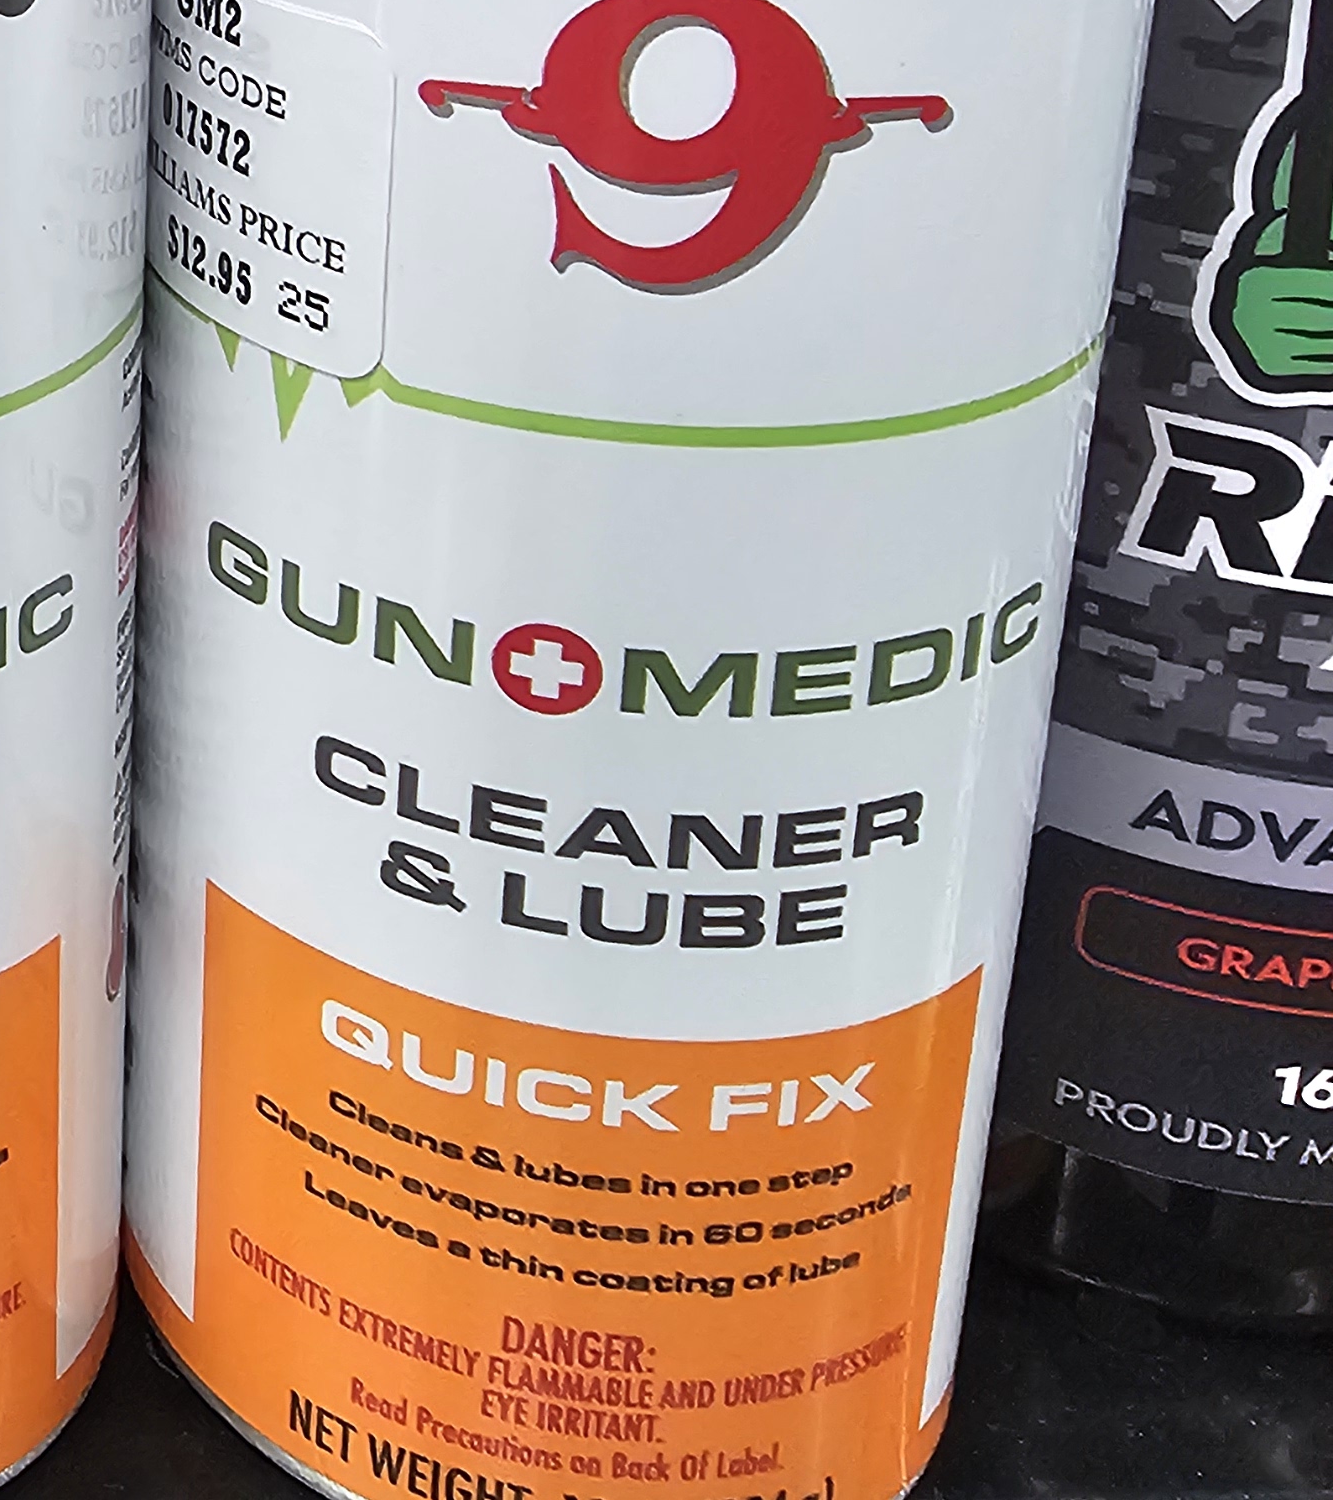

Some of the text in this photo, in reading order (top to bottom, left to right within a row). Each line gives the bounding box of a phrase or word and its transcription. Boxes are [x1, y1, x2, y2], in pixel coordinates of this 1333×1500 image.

[163, 83, 251, 177] 017572
[199, 55, 287, 120] CODE
[167, 213, 252, 306] $12.95
[278, 280, 330, 332] 25
[239, 203, 347, 274] PRICE
[1119, 405, 1333, 595] R
[314, 735, 925, 870] CLEANER
[379, 840, 847, 949] & LUBE
[1176, 936, 1333, 990] GRAP
[320, 1000, 876, 1133] QUICK FIX
[255, 1094, 912, 1245] Cleaner evaporates 60 seconds
[329, 1089, 854, 1193] Cleans lubes step
[1054, 1077, 1291, 1162] PROUDLY
[304, 1169, 861, 1298] Leaves thin coating lube
[230, 1228, 654, 1409] CONTENTS EXTREMELY FLAMMABLE
[501, 1315, 656, 1374] DANGER:
[289, 1388, 357, 1463] NET
[351, 1376, 563, 1472] Read Precautions
[481, 1388, 666, 1443] EYE IRRITANT.
